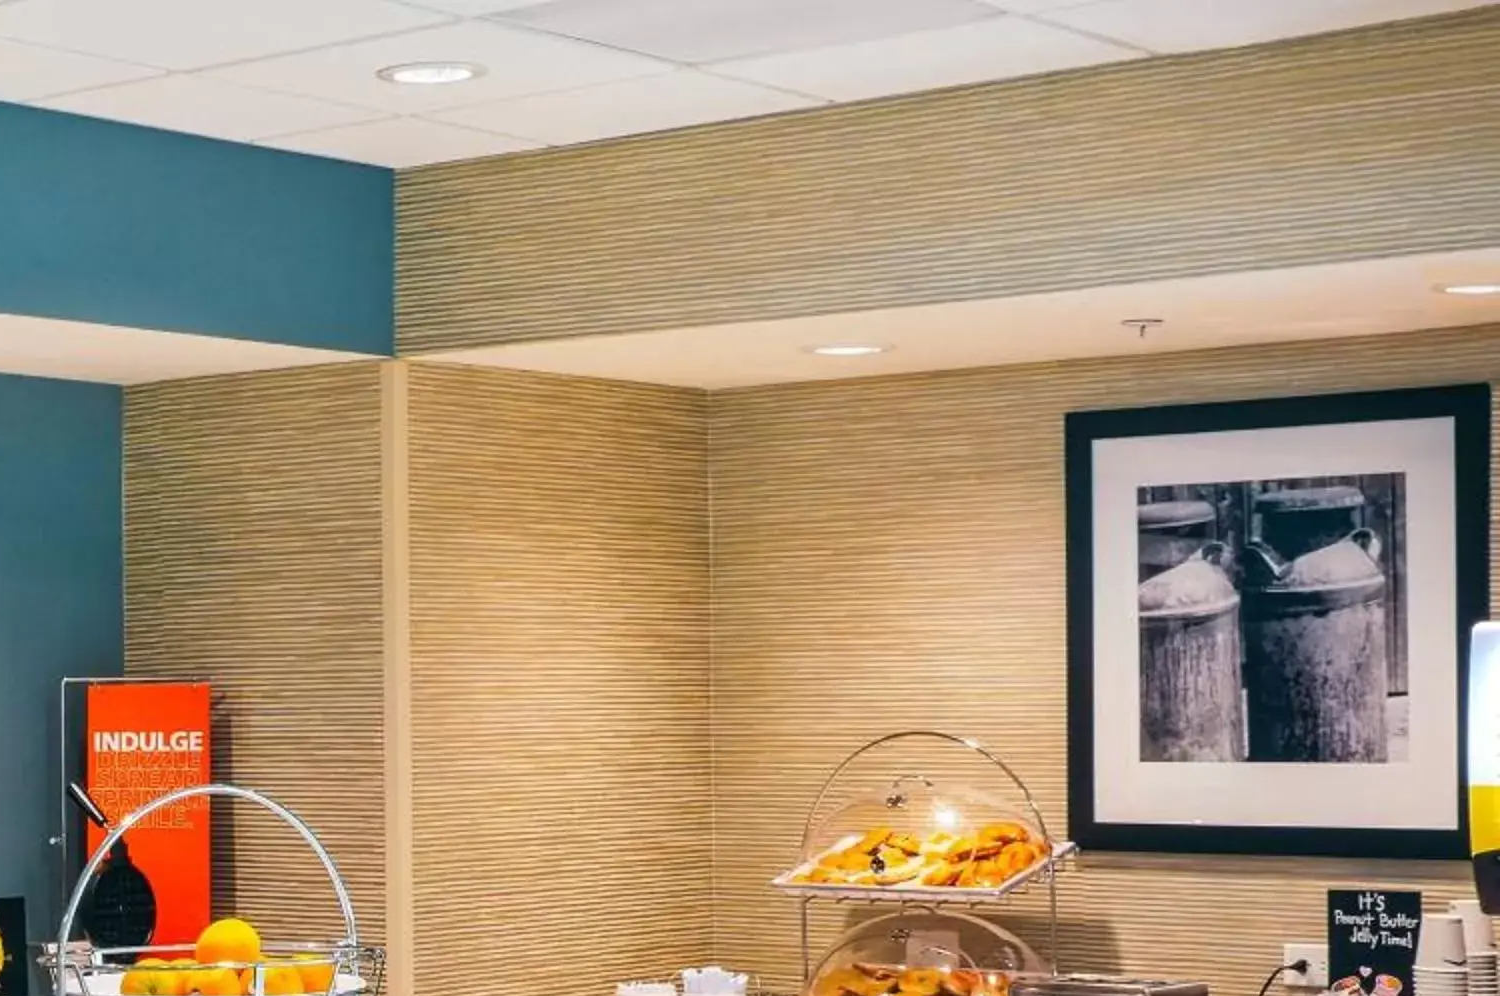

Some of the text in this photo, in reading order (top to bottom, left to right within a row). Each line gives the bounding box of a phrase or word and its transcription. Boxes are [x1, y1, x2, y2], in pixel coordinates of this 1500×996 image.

[94, 731, 204, 753] INDULGE
[98, 752, 201, 770] DRIZZLE
[96, 769, 201, 789] SPREAD
